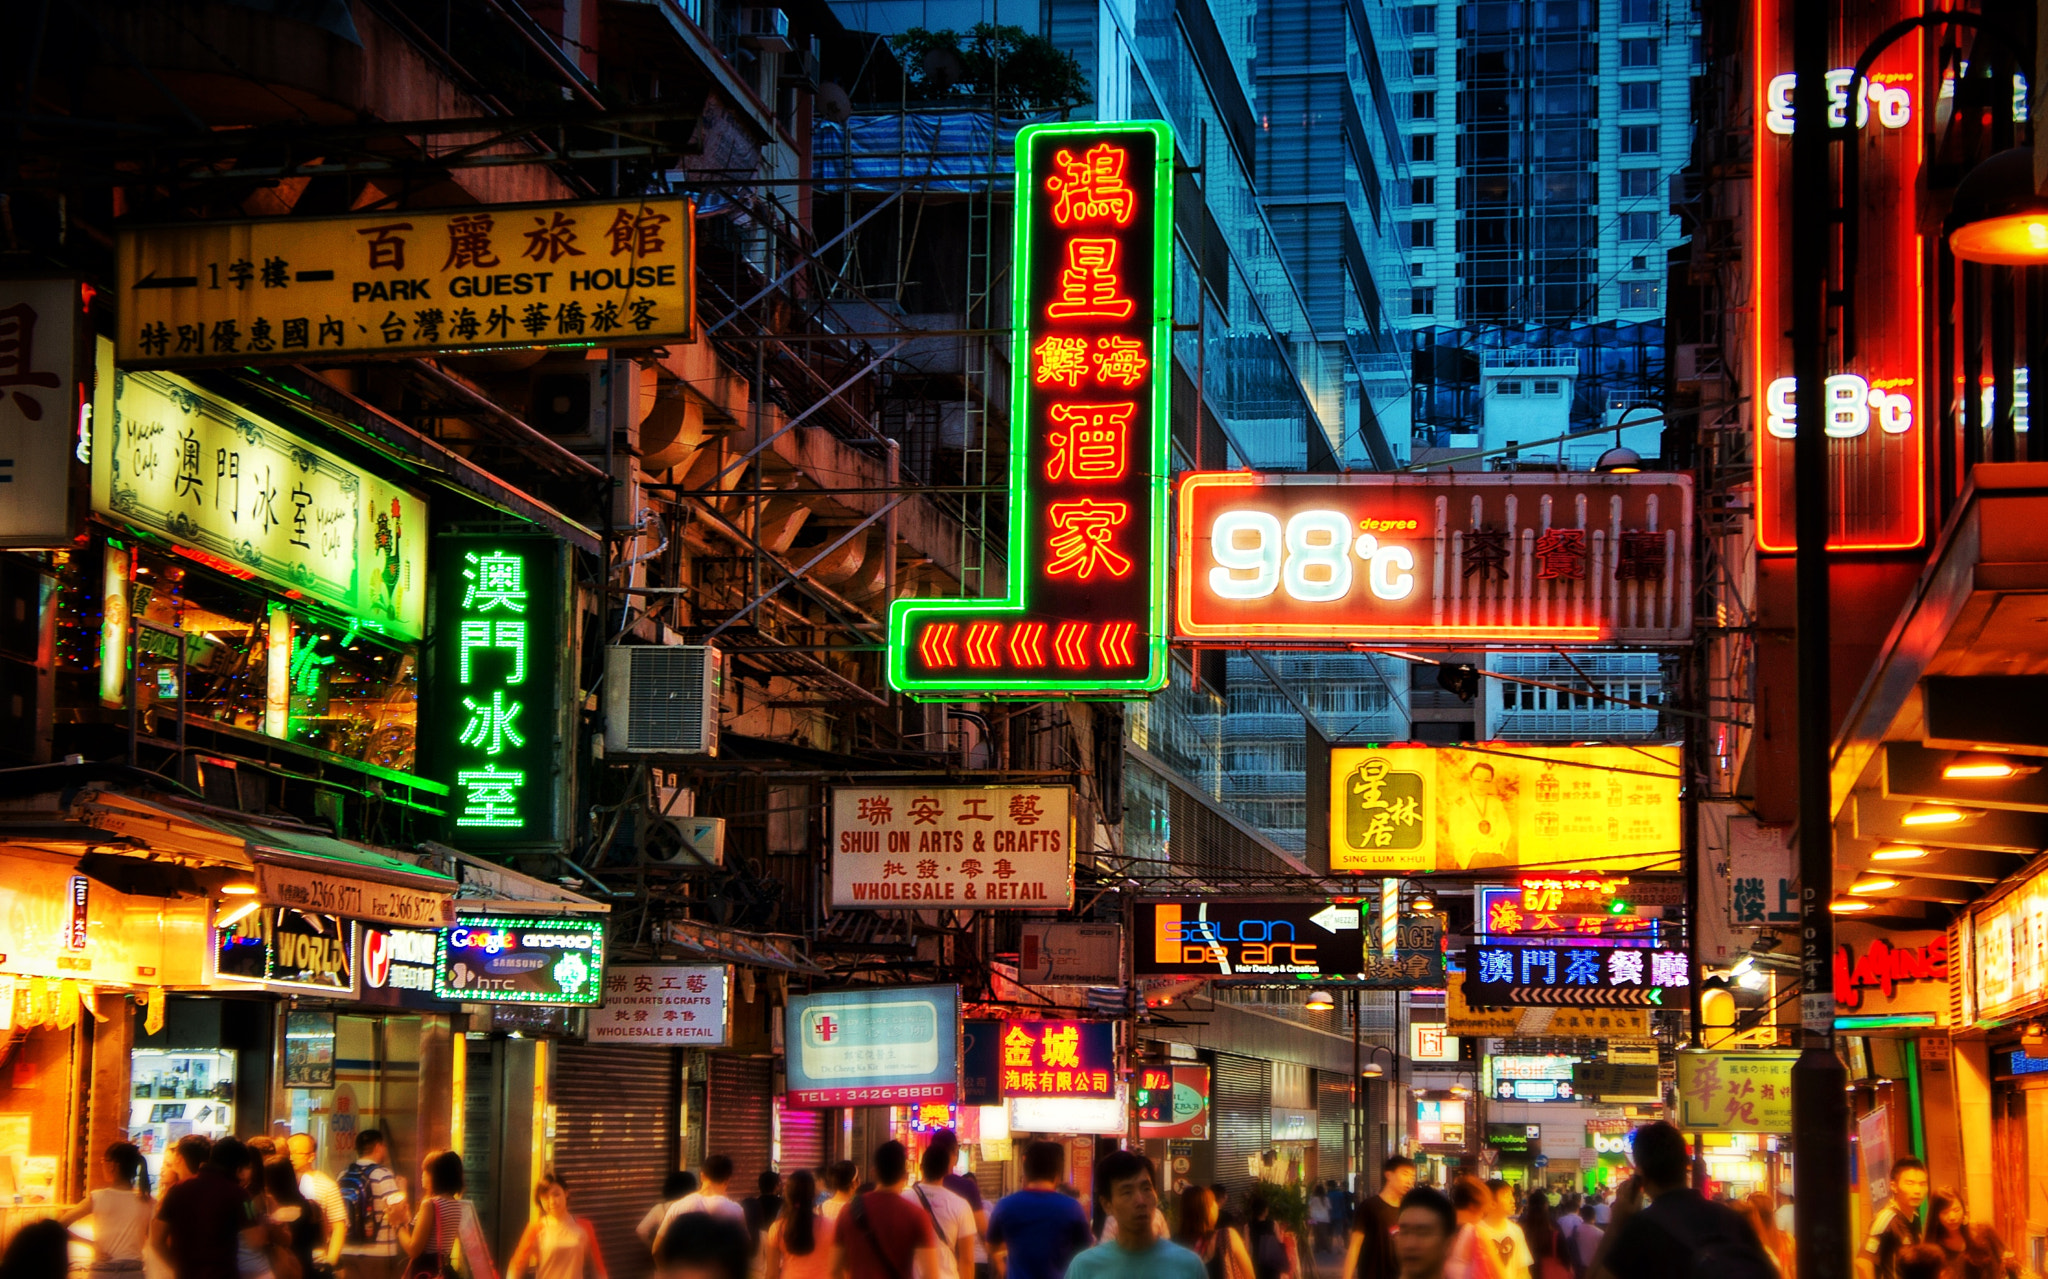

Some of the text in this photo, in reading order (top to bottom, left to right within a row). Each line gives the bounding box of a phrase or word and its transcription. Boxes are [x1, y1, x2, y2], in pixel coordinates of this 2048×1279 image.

[357, 207, 671, 272] 百麗旅館
[352, 265, 676, 303] PARK GUEST HOUSE
[174, 427, 312, 550] 澳門冰室
[1359, 517, 1418, 531] degree
[1462, 528, 1667, 581] 茶餐廳
[457, 551, 527, 826] 澳門冰室
[857, 794, 1045, 826] 瑞安工藝
[841, 830, 1061, 853] SHUI ON ARTS & CRAFTS
[1343, 854, 1426, 864] SING LUM KHUI
[311, 880, 335, 907] 2366
[338, 884, 362, 914] 8771
[390, 893, 412, 919] 2366
[414, 893, 436, 922] 8772
[852, 882, 1047, 901] WHOLESALE & RETAIL
[278, 931, 342, 973] WORLD
[451, 929, 515, 953] Google
[492, 958, 543, 968] SAMSUNG
[1253, 964, 1279, 974] Design
[1479, 949, 1689, 988] 澳門茶餐廳
[606, 974, 707, 993] 瑞安工藝
[623, 997, 636, 1005] ON
[638, 997, 663, 1005] ARTS
[665, 997, 672, 1005] &
[674, 997, 711, 1005] CRAFTS
[597, 1027, 713, 1037] WHOLESALE & RETAIL
[1004, 1026, 1079, 1068] 金城
[1004, 1071, 1108, 1093] 海味有限公司
[799, 1092, 830, 1102] TEL
[846, 1086, 944, 1100] 3426-8880
